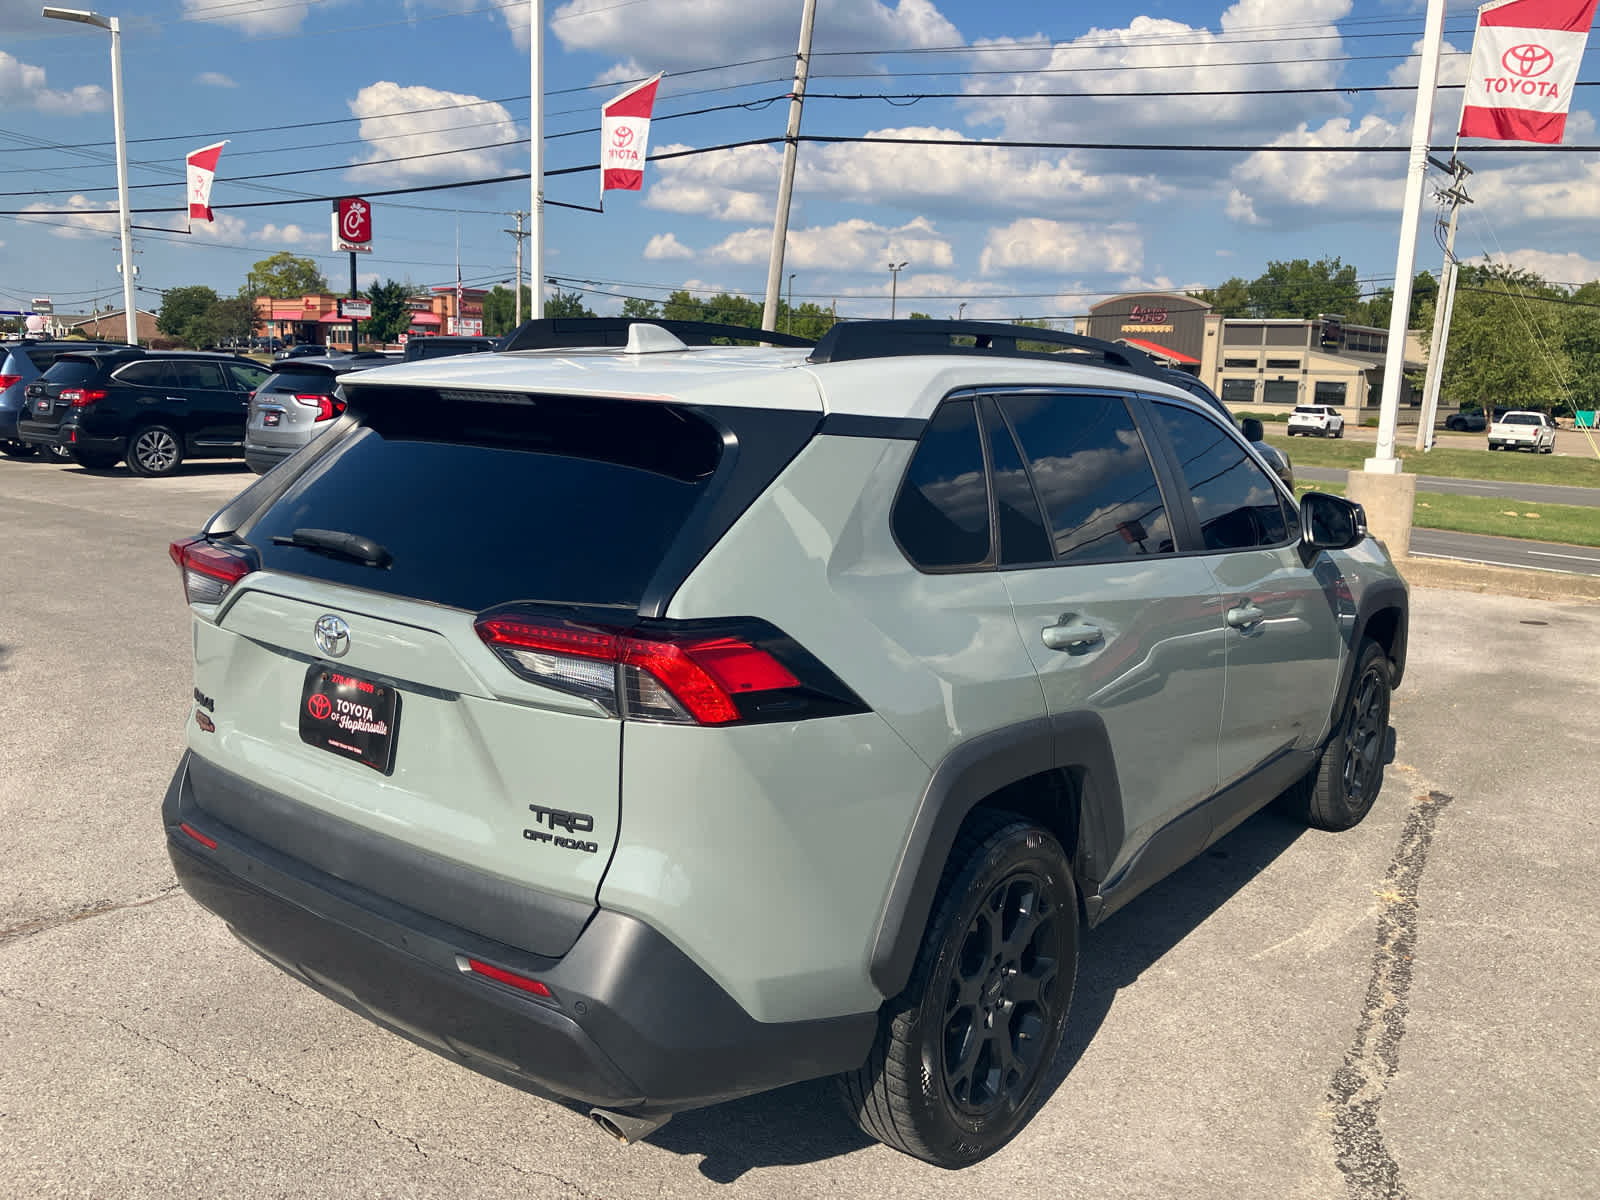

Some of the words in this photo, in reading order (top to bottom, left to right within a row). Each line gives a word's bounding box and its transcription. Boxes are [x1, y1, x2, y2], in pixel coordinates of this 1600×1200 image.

[1484, 77, 1559, 99] TOYOTA
[330, 712, 340, 721] OF
[336, 699, 373, 721] TOYOTA
[528, 803, 594, 834] TRD
[523, 828, 553, 843] OFF
[554, 835, 598, 854] ROAD
